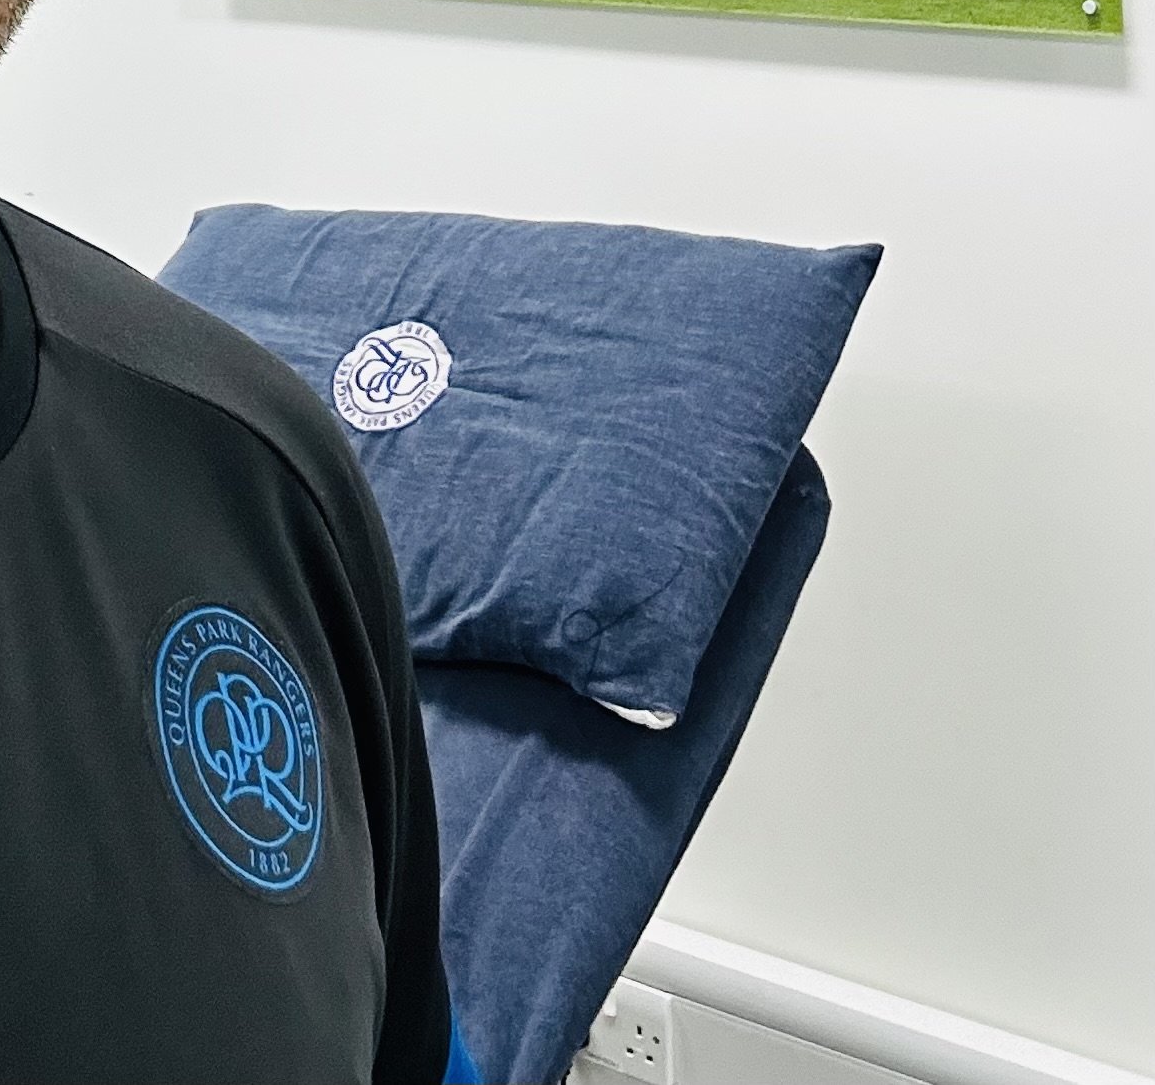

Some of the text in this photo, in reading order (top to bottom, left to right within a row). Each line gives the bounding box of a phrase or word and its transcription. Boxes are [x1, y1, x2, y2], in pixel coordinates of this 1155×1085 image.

[164, 620, 315, 757] QUEENS PARK RANGERS
[249, 849, 291, 876] 1882
